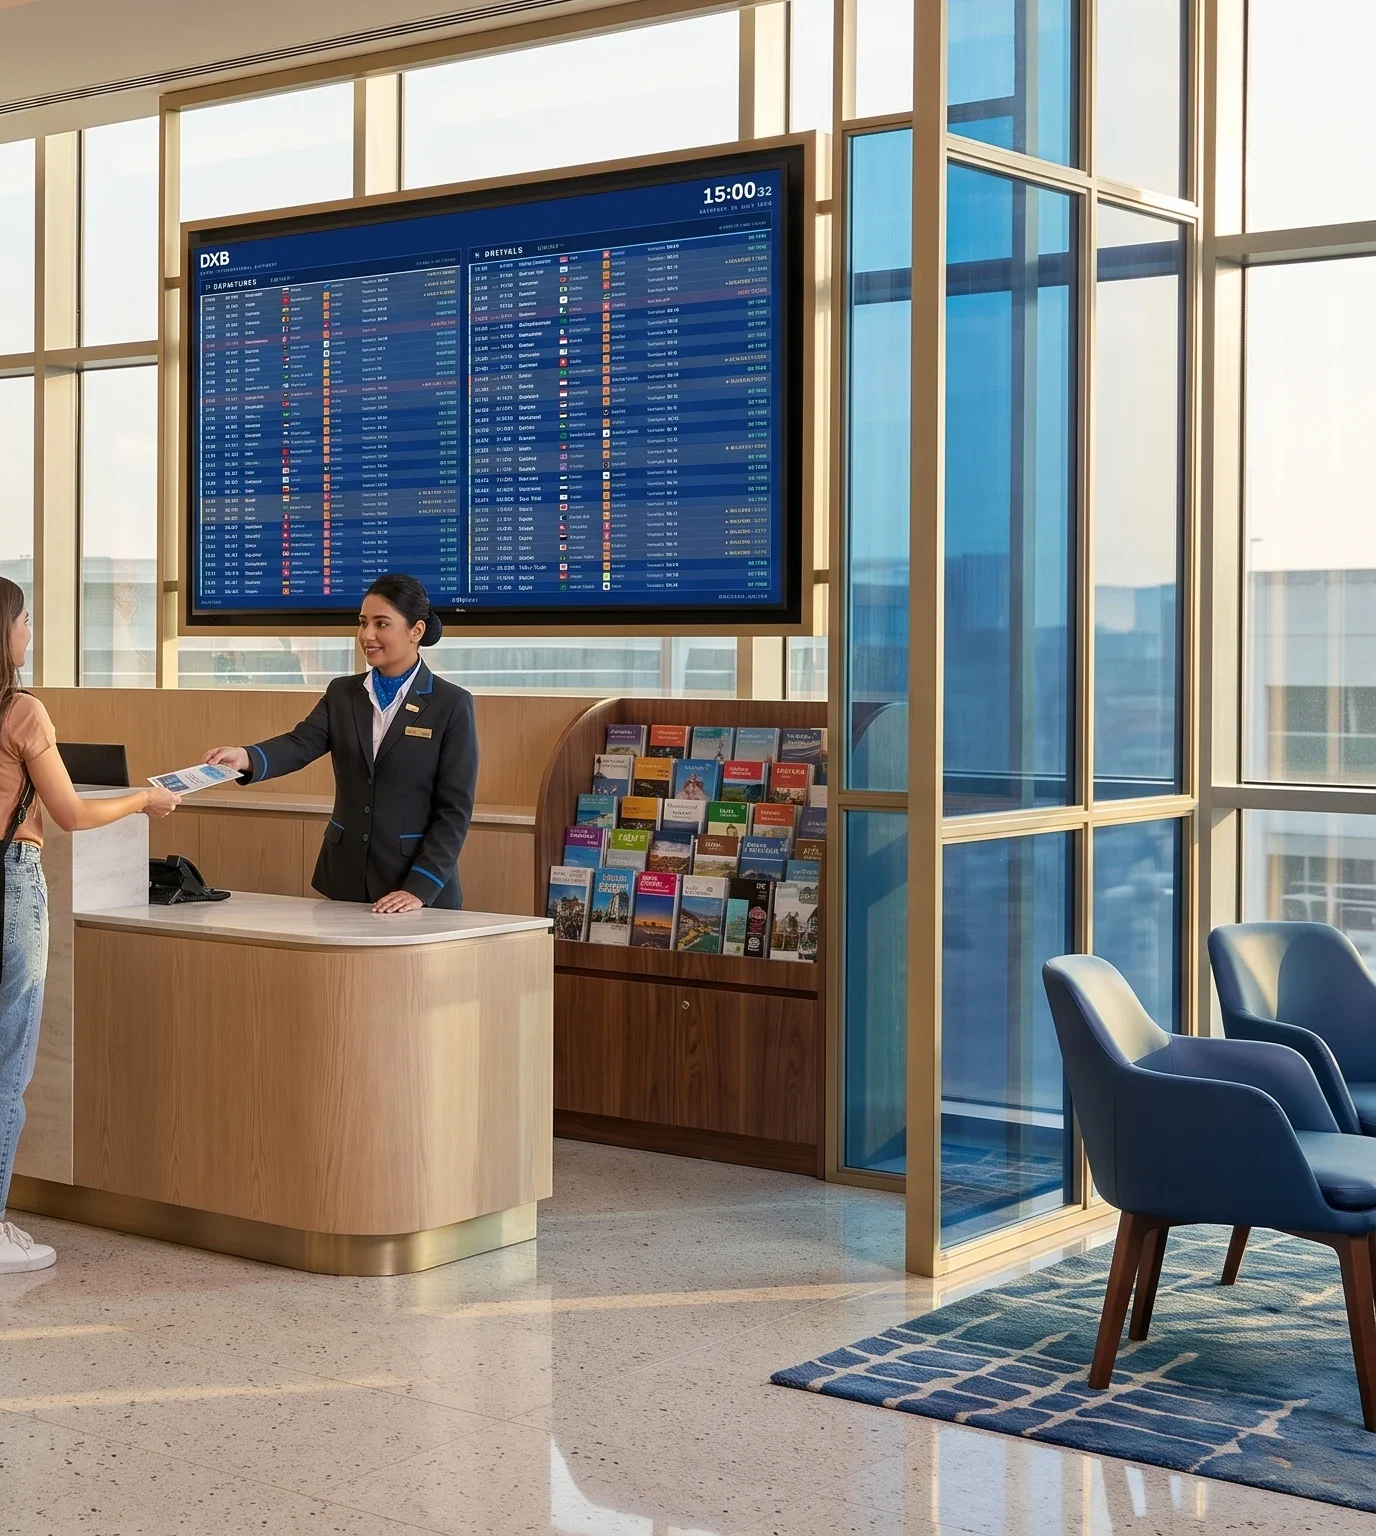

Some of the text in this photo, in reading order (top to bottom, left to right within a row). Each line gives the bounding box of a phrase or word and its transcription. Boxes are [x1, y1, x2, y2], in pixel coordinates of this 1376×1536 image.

[703, 181, 772, 204] 15:00 32
[200, 251, 230, 269] DXB
